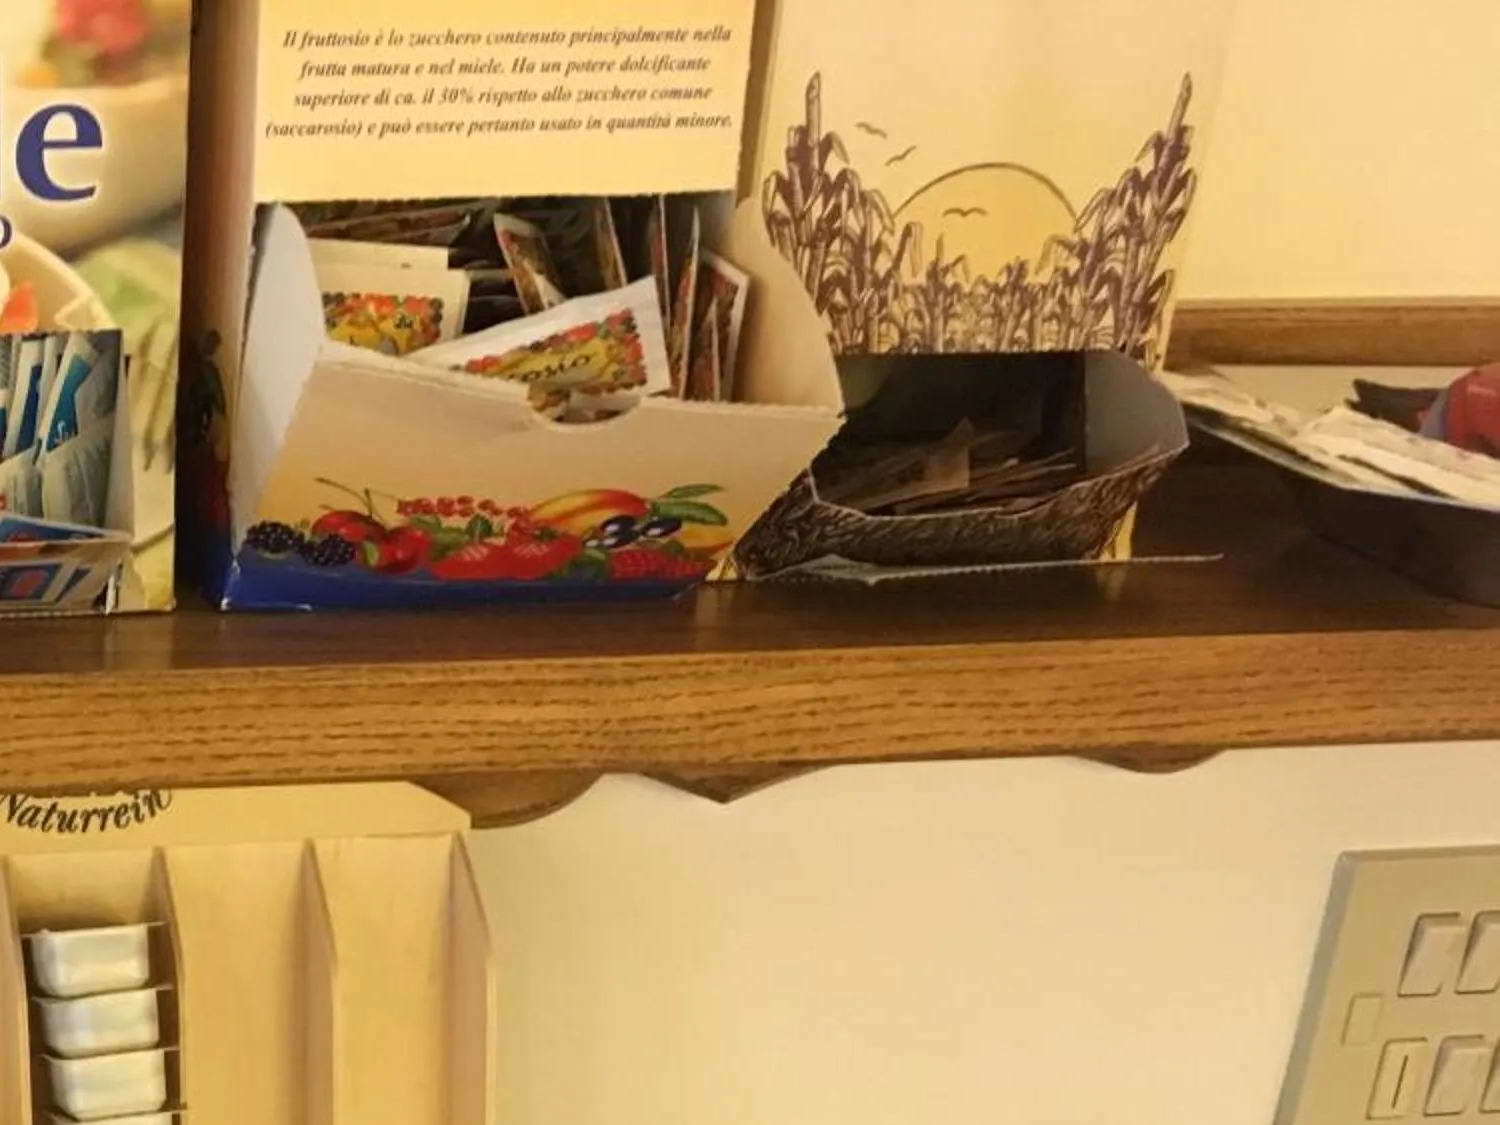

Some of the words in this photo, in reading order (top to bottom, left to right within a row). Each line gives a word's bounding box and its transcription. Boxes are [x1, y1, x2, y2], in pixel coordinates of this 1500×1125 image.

[283, 30, 297, 48] Il
[299, 30, 369, 51] fruttosio
[388, 28, 403, 46] lo
[409, 29, 482, 47] zucchero
[486, 29, 566, 45] contenuto
[568, 26, 688, 47] principalmente
[693, 25, 732, 42] nella
[298, 60, 346, 81] frutta
[351, 62, 410, 76] matura
[415, 63, 425, 75] e
[429, 58, 453, 75] nel
[459, 57, 505, 75] miele.
[512, 56, 535, 73] Ha
[540, 60, 561, 73] un
[564, 59, 615, 77] potere
[620, 56, 711, 74] dolcificante
[294, 88, 372, 110] superiore
[374, 87, 391, 105] di
[394, 93, 416, 105] ca.
[422, 87, 435, 104] il
[438, 86, 474, 104] 30%
[478, 87, 537, 107] rispetto
[541, 85, 572, 101] allo
[577, 85, 647, 103] zucchero
[650, 86, 713, 99] comune
[265, 118, 363, 137] (saccarosio)
[367, 122, 378, 134] e
[378, 117, 411, 139] può
[416, 121, 465, 134] essere
[468, 117, 535, 137] pertanto
[540, 115, 582, 131] usato
[586, 114, 602, 130] in
[606, 113, 671, 133] quantità
[675, 112, 733, 129] minore.
[507, 354, 590, 381] osio
